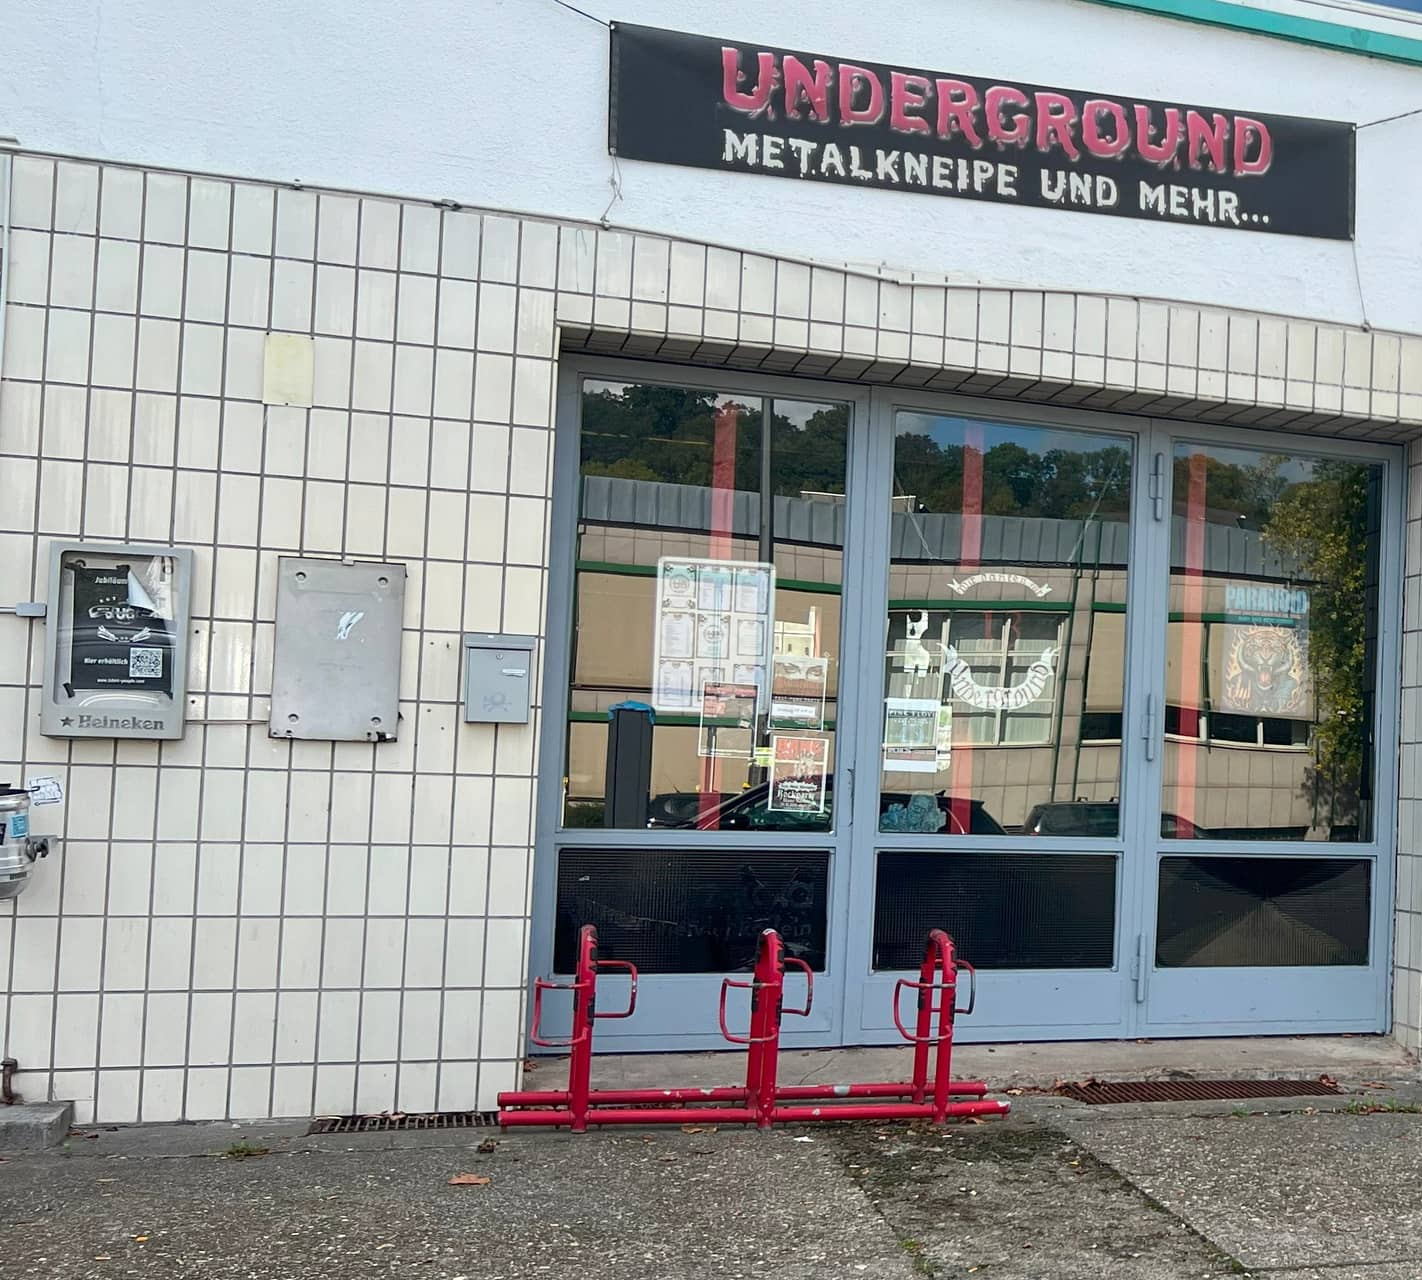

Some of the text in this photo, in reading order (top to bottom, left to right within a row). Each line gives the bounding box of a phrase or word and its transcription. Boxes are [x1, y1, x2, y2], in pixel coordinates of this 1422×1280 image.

[720, 46, 1275, 176] UNDERGROUND
[722, 128, 1270, 226] METALKNEIPE UND MEHR...
[78, 715, 164, 730] Heineken
